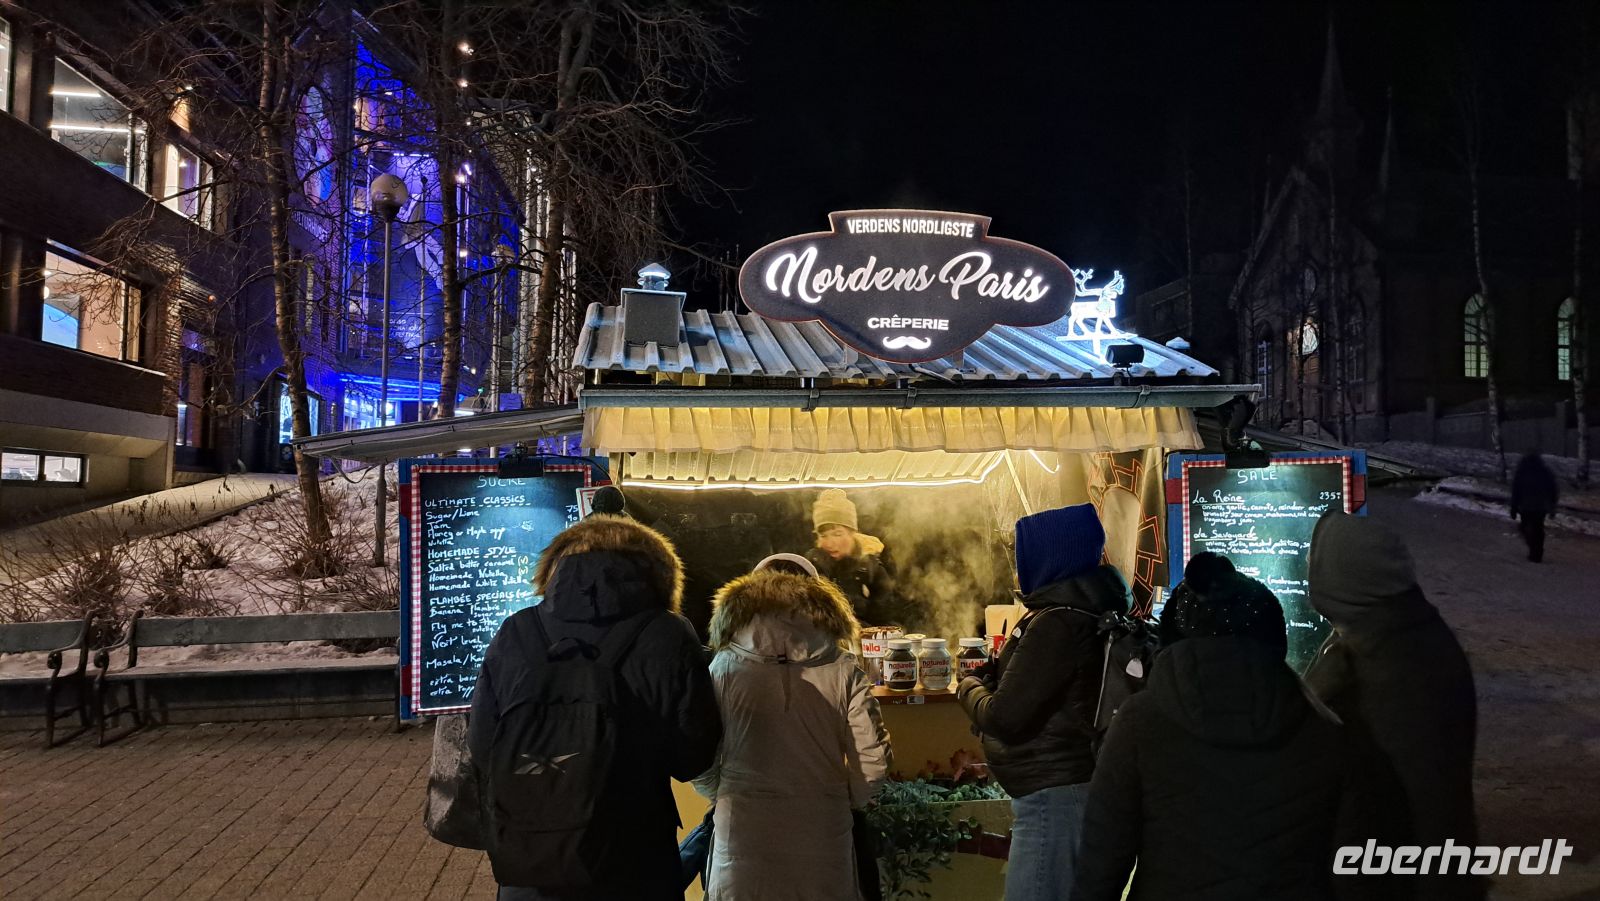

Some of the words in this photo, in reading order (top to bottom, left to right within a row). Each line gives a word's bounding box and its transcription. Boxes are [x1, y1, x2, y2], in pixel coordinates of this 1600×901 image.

[847, 219, 900, 234] VERDENS
[902, 219, 975, 238] NORDLIGSTE
[765, 247, 935, 304] Nordens
[938, 252, 1050, 303] Paris
[867, 314, 949, 331] CRÊPERIE
[1192, 490, 1208, 504] La
[428, 547, 480, 559] HOMEMADE
